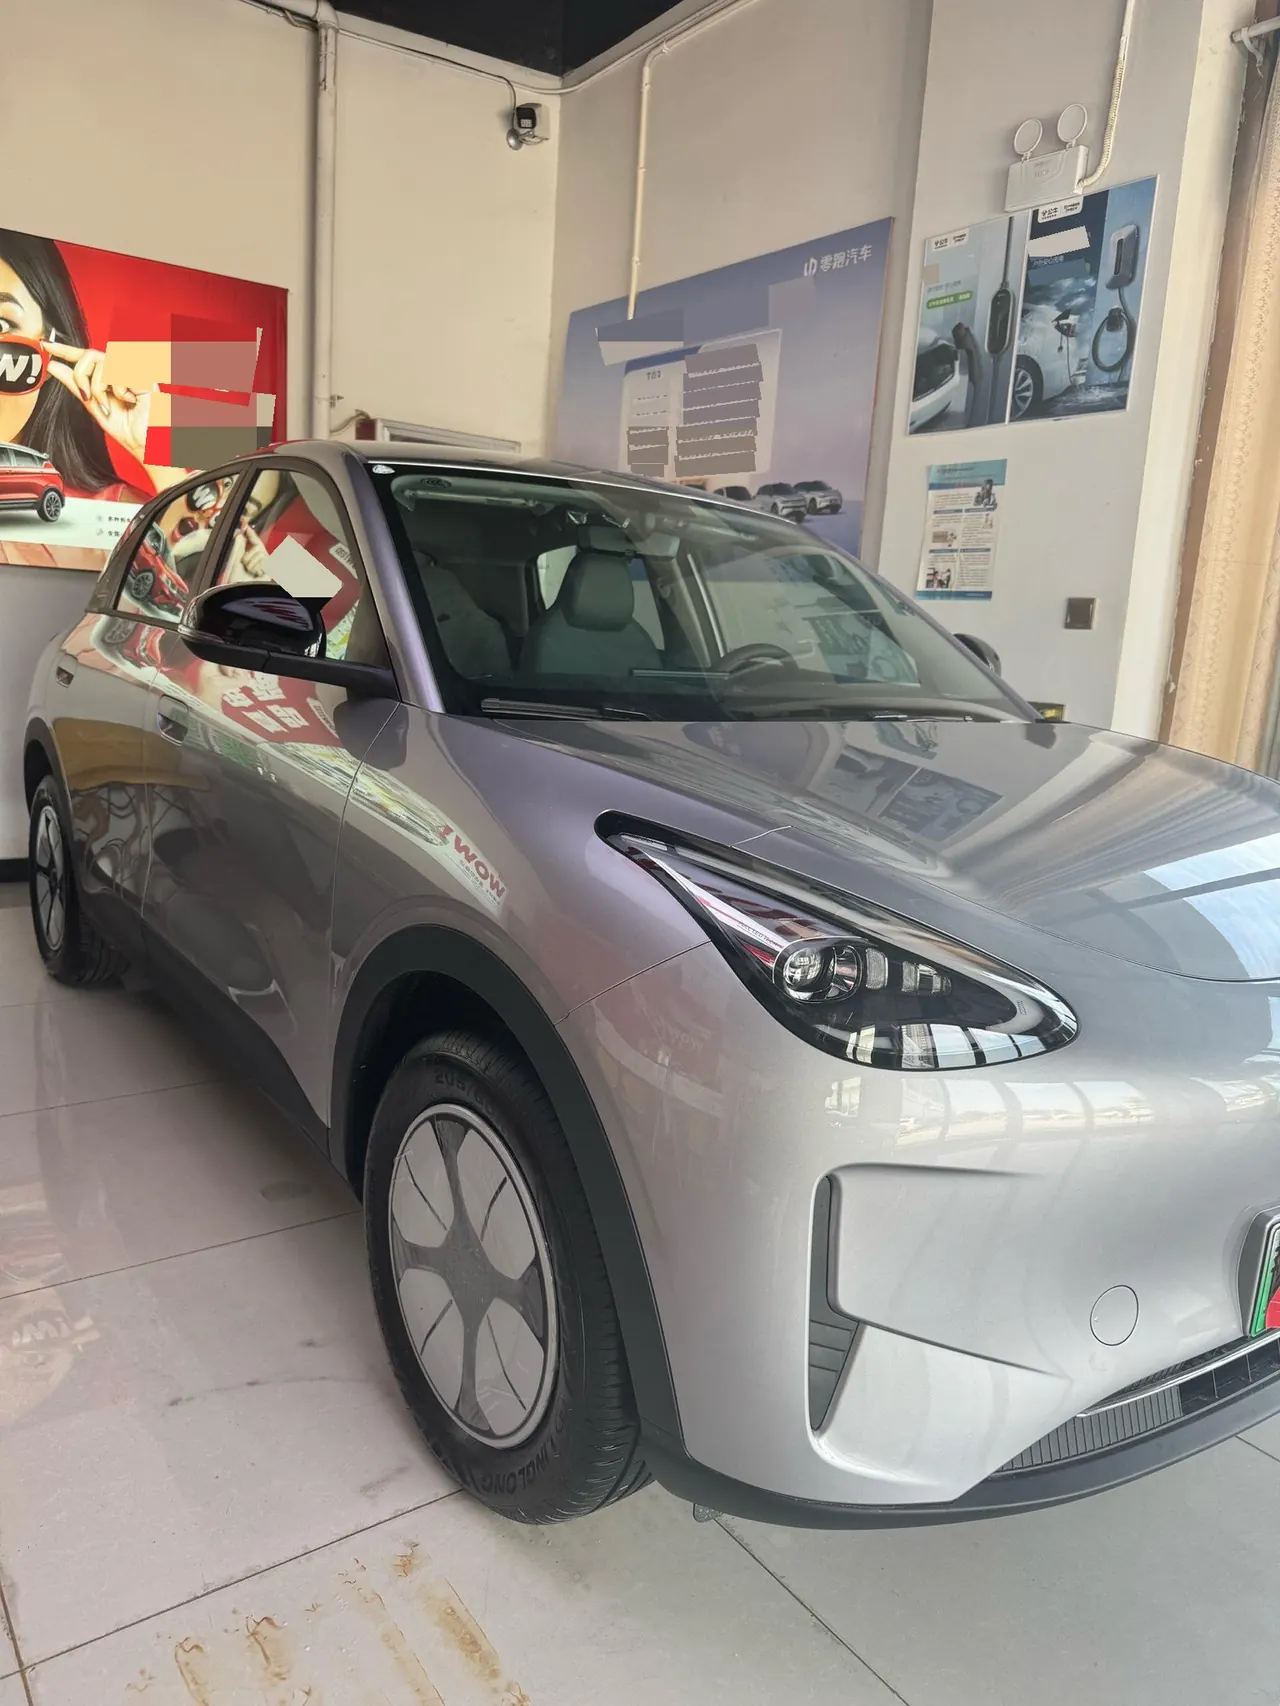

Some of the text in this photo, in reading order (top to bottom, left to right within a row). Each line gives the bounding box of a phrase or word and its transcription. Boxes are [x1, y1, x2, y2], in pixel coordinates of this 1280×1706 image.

[820, 244, 872, 272] 零跑汽车
[481, 1435, 558, 1494] LINGLONG
